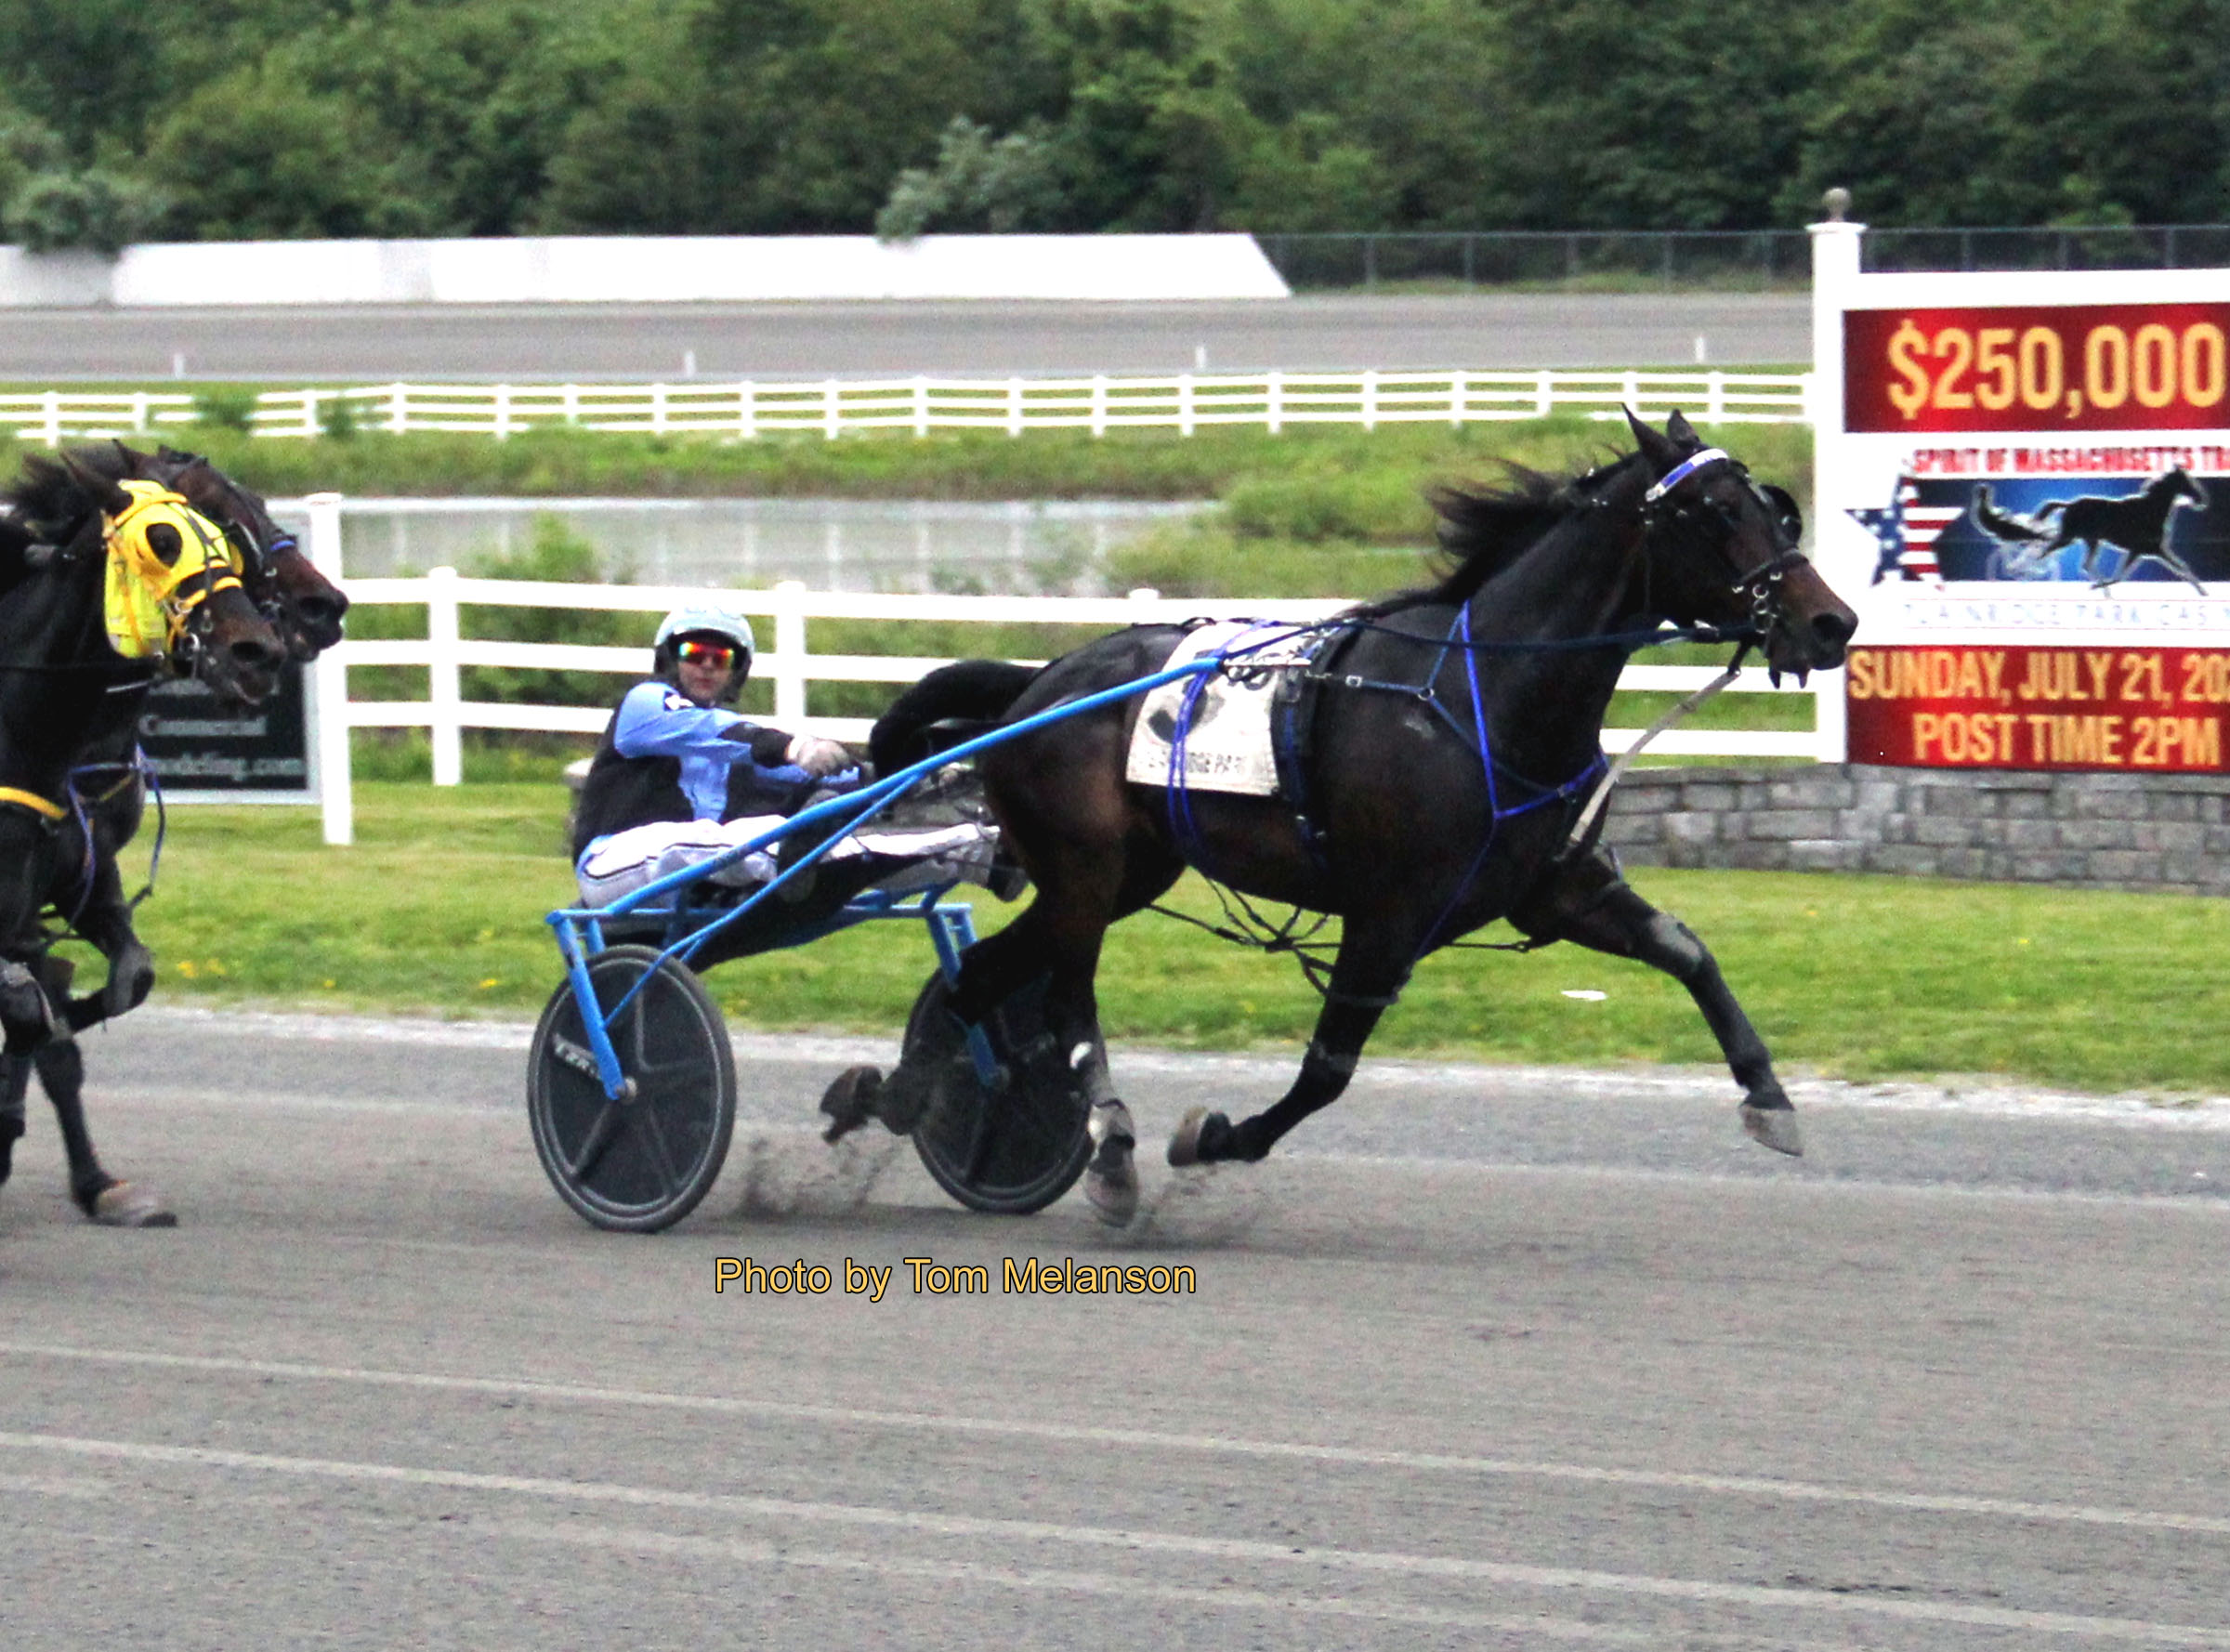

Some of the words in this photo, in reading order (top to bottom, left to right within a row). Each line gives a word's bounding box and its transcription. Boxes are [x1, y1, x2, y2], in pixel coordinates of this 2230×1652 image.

[1887, 319, 2226, 420] $250,000
[1848, 649, 2012, 707] SUNDAY,
[2017, 651, 2115, 701] JULY
[2119, 652, 2173, 710] 21,
[2180, 652, 2230, 703] 20
[1912, 712, 2019, 762] POST
[2026, 713, 2123, 764] TIME
[2132, 715, 2221, 767] 2PM
